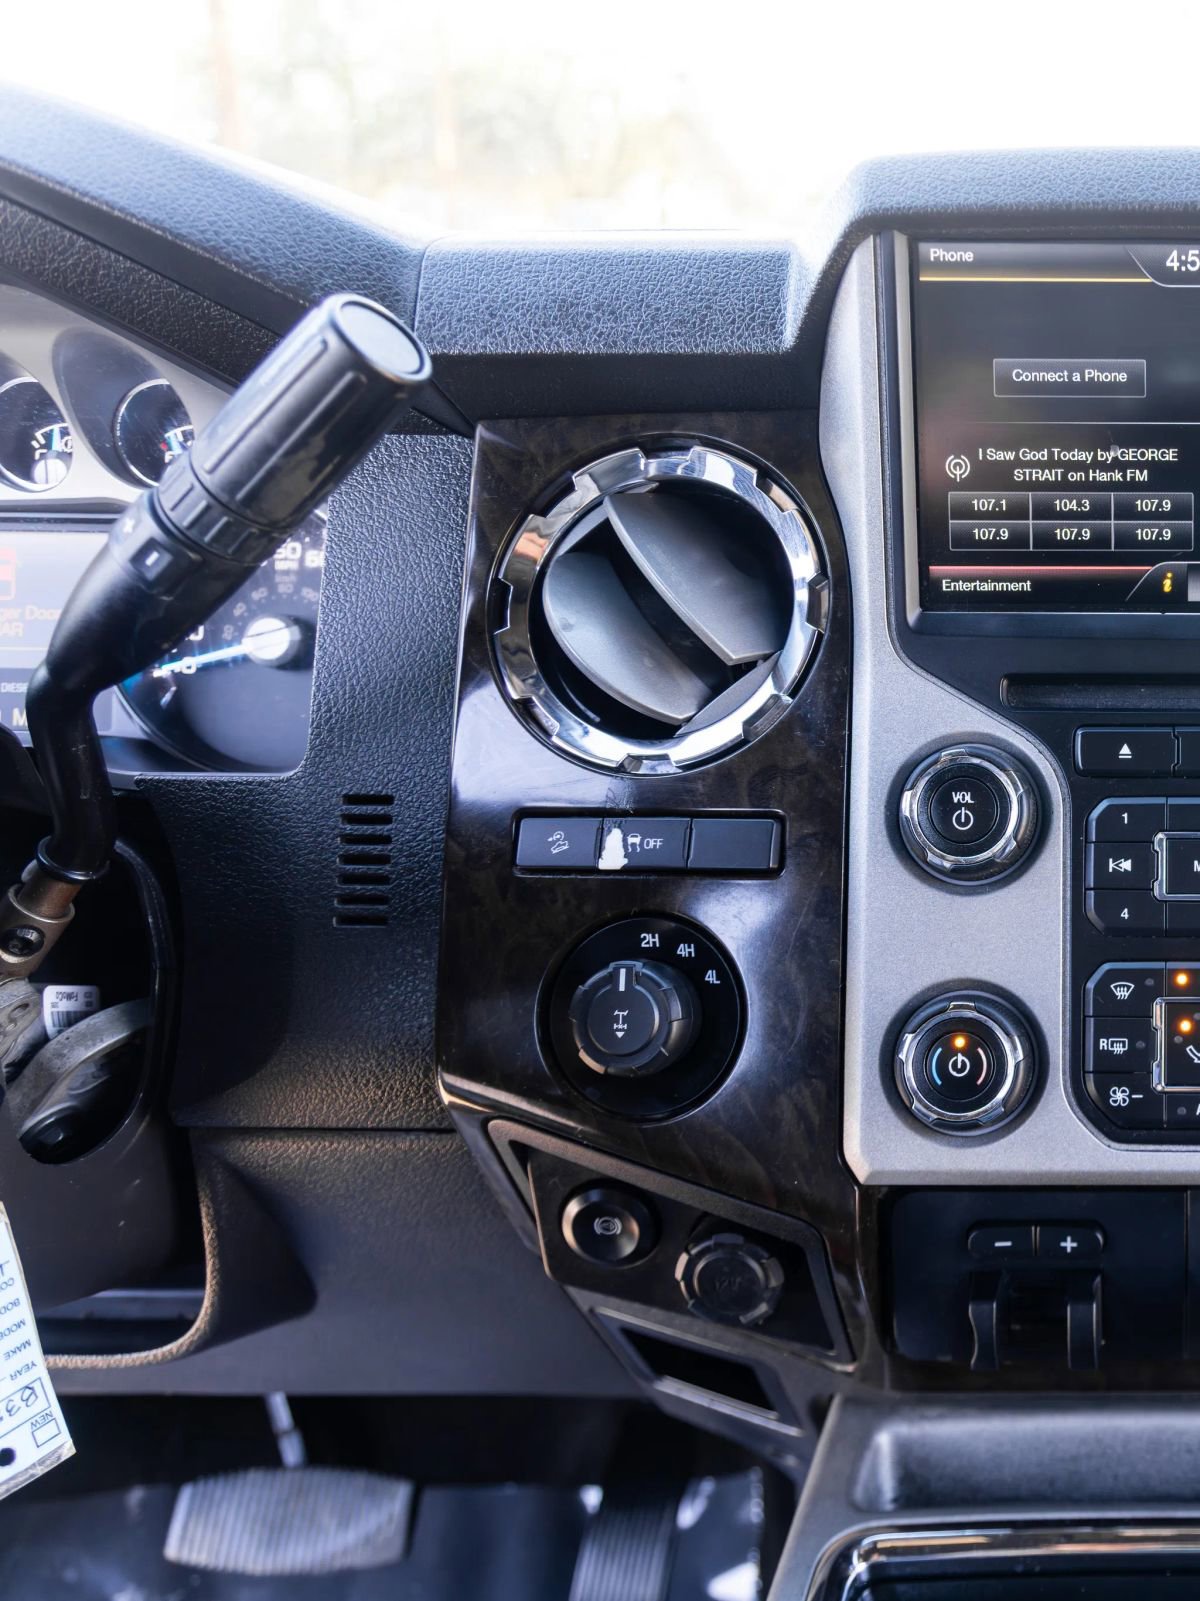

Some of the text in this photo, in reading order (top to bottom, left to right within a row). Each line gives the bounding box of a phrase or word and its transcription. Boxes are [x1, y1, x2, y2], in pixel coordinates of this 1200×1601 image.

[930, 248, 974, 262] Phone
[1012, 368, 1128, 382] Connect a Phone
[978, 449, 1178, 464] I Saw God Today by GEORGE
[1013, 469, 1148, 482] STRAIT on Hank FM
[971, 499, 1008, 512] 107.1
[1054, 499, 1090, 512] 104.3
[1135, 499, 1171, 512] 107.9
[972, 528, 1009, 541] 107.9
[1054, 528, 1091, 541] 107.9
[1135, 528, 1171, 541] 107.9
[942, 579, 1031, 592] Entertainment
[951, 791, 975, 804] VOL
[1121, 812, 1129, 824] 1
[643, 838, 664, 850] OFF
[1120, 908, 1129, 920] 4
[640, 933, 660, 948] 2H
[676, 943, 696, 958] 4H
[704, 969, 721, 985] 4L
[4, 1339, 32, 1361] MAKE
[10, 1360, 38, 1382] YEAR
[30, 1410, 54, 1430] NEW
